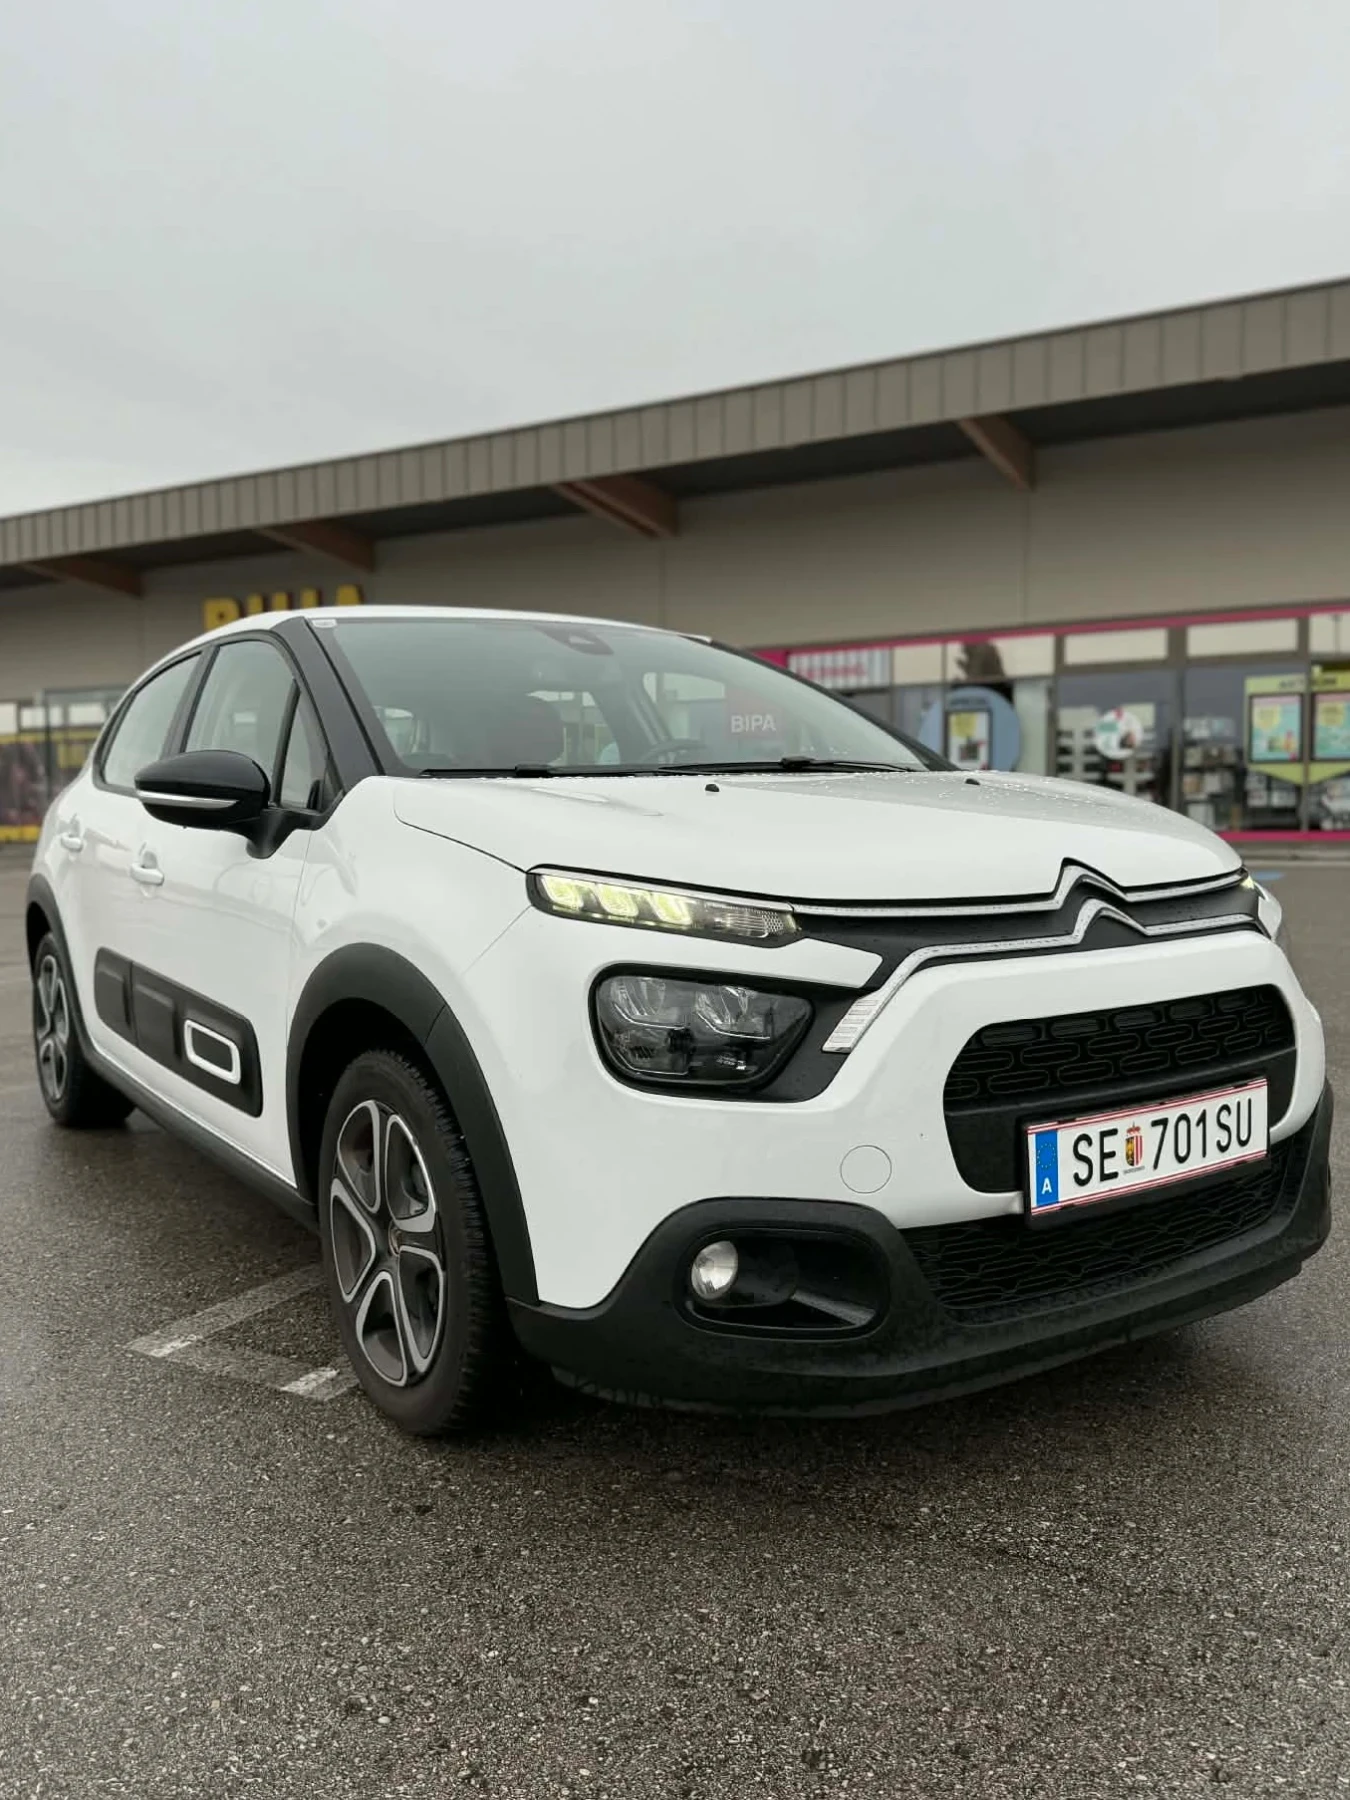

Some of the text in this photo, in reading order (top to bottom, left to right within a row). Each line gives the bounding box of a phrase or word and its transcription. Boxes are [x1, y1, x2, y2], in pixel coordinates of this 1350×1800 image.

[731, 714, 777, 733] BIPA
[1072, 1127, 1119, 1187] SE
[1041, 1177, 1052, 1194] A
